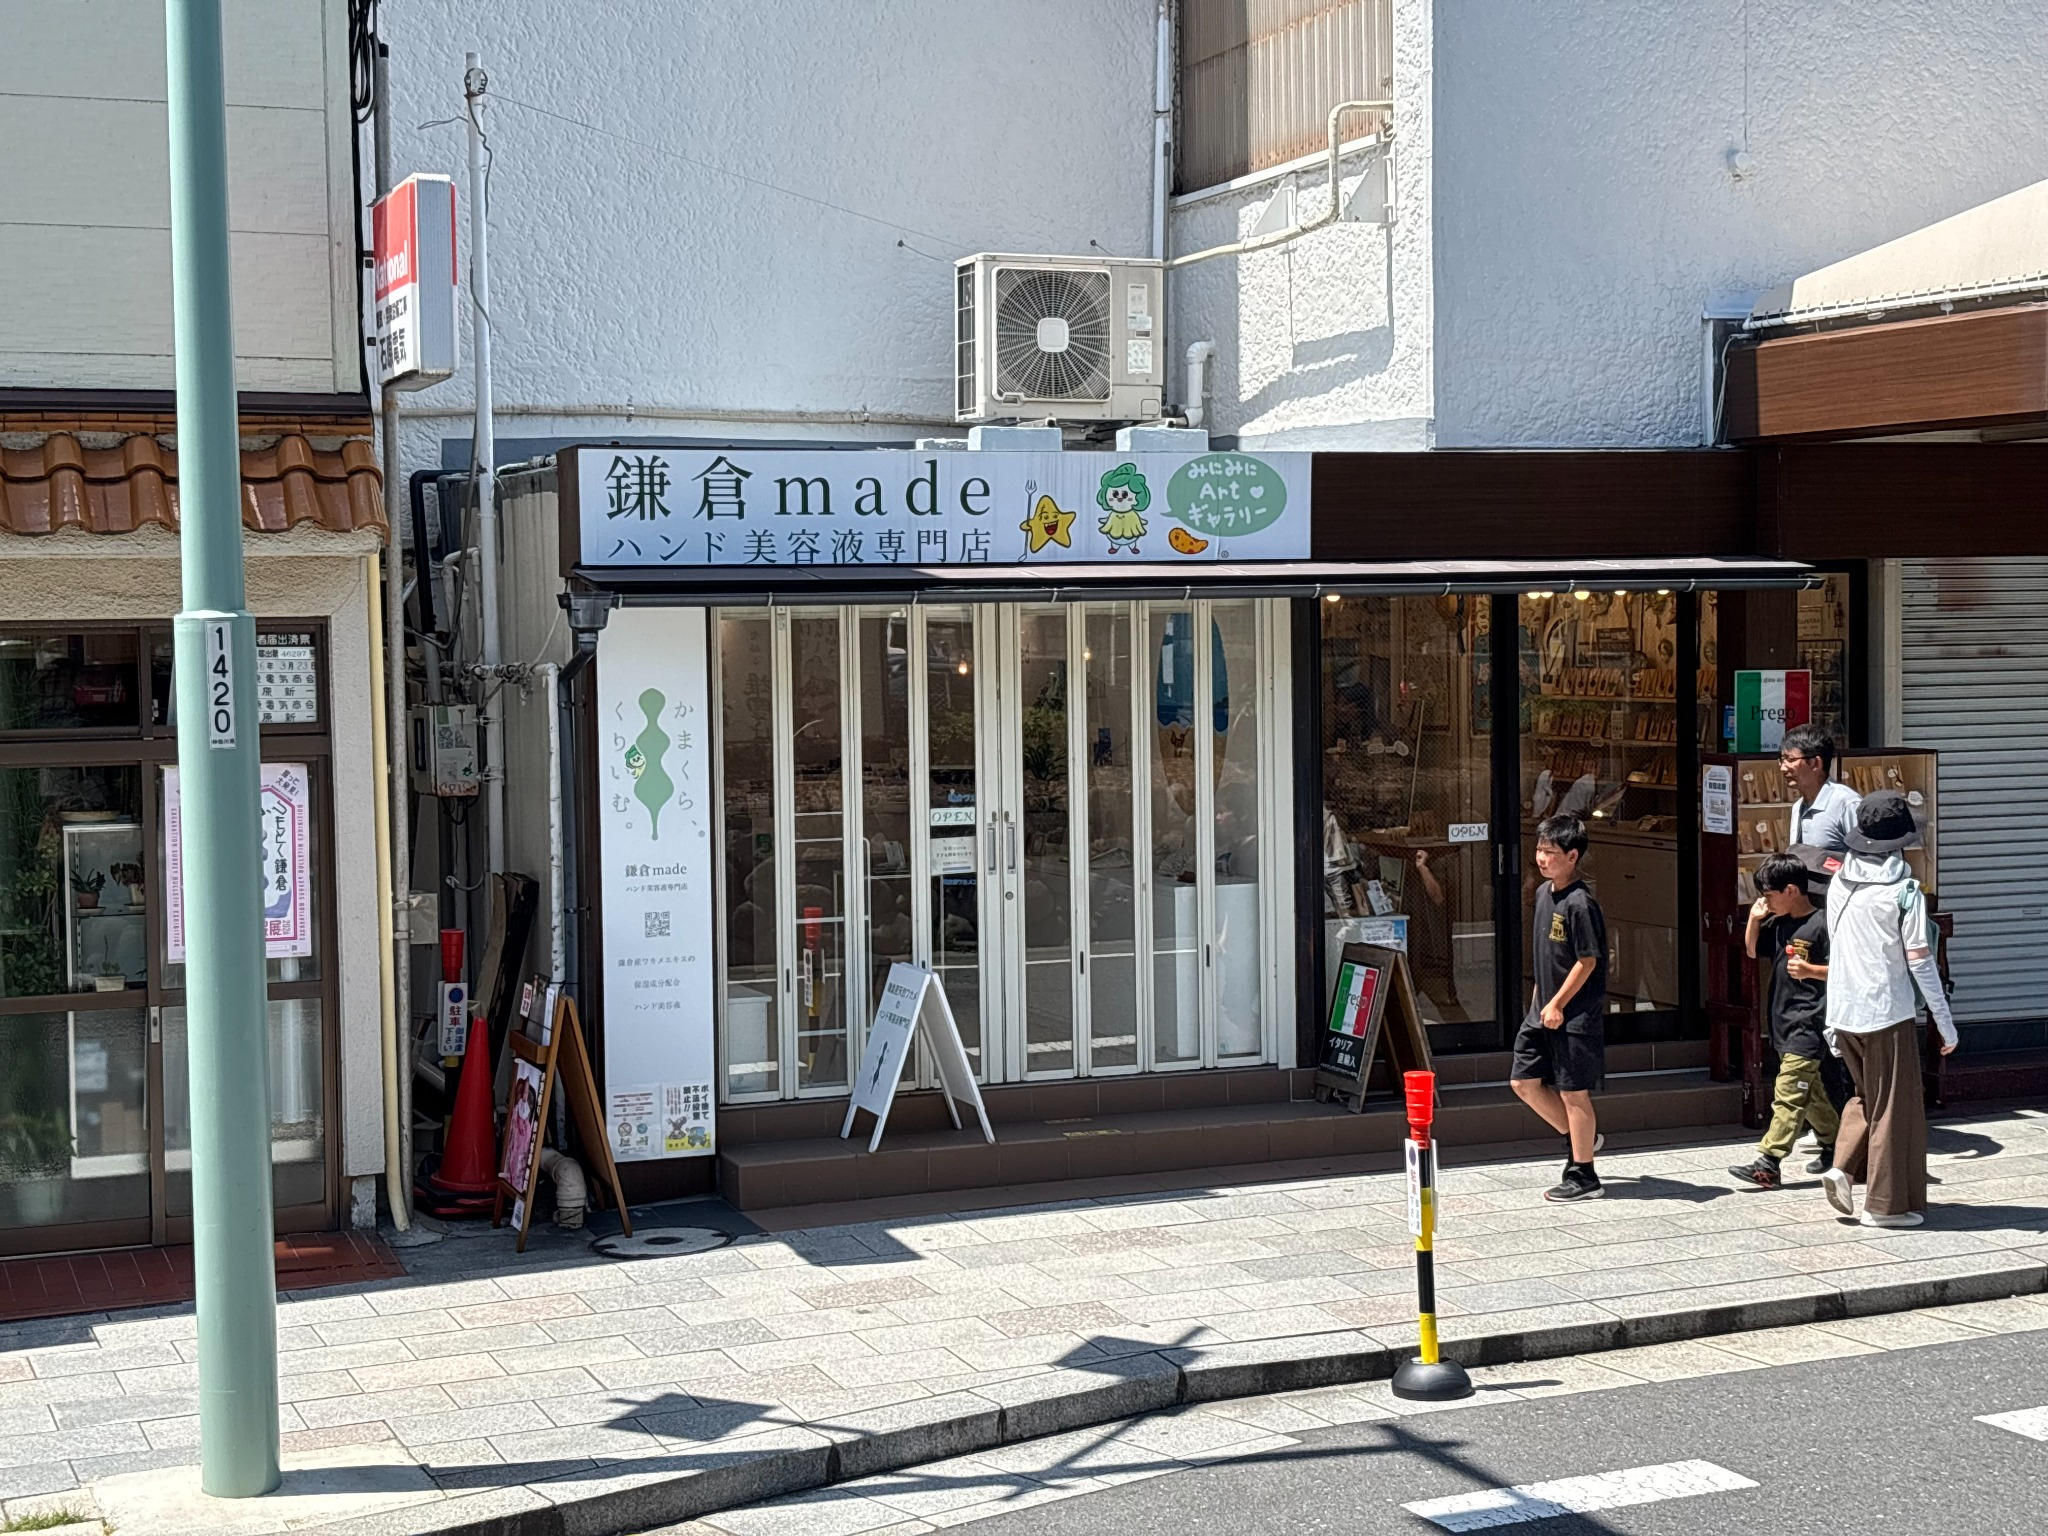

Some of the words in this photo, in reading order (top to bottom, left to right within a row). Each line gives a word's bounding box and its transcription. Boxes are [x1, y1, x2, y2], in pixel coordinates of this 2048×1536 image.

[1188, 458, 1257, 479] みにみに
[605, 455, 992, 522] 鎌倉made
[1200, 481, 1240, 500] Art
[1188, 502, 1267, 528] ギャラリー
[607, 528, 991, 564] ハンド美容液専門店
[213, 626, 231, 733] 1420
[1750, 705, 1796, 724] Prego
[931, 811, 974, 823] OPEN
[1450, 825, 1487, 838] OPEN
[272, 800, 289, 891] ひもとく鎌倉
[1329, 1036, 1354, 1052] イタリア
